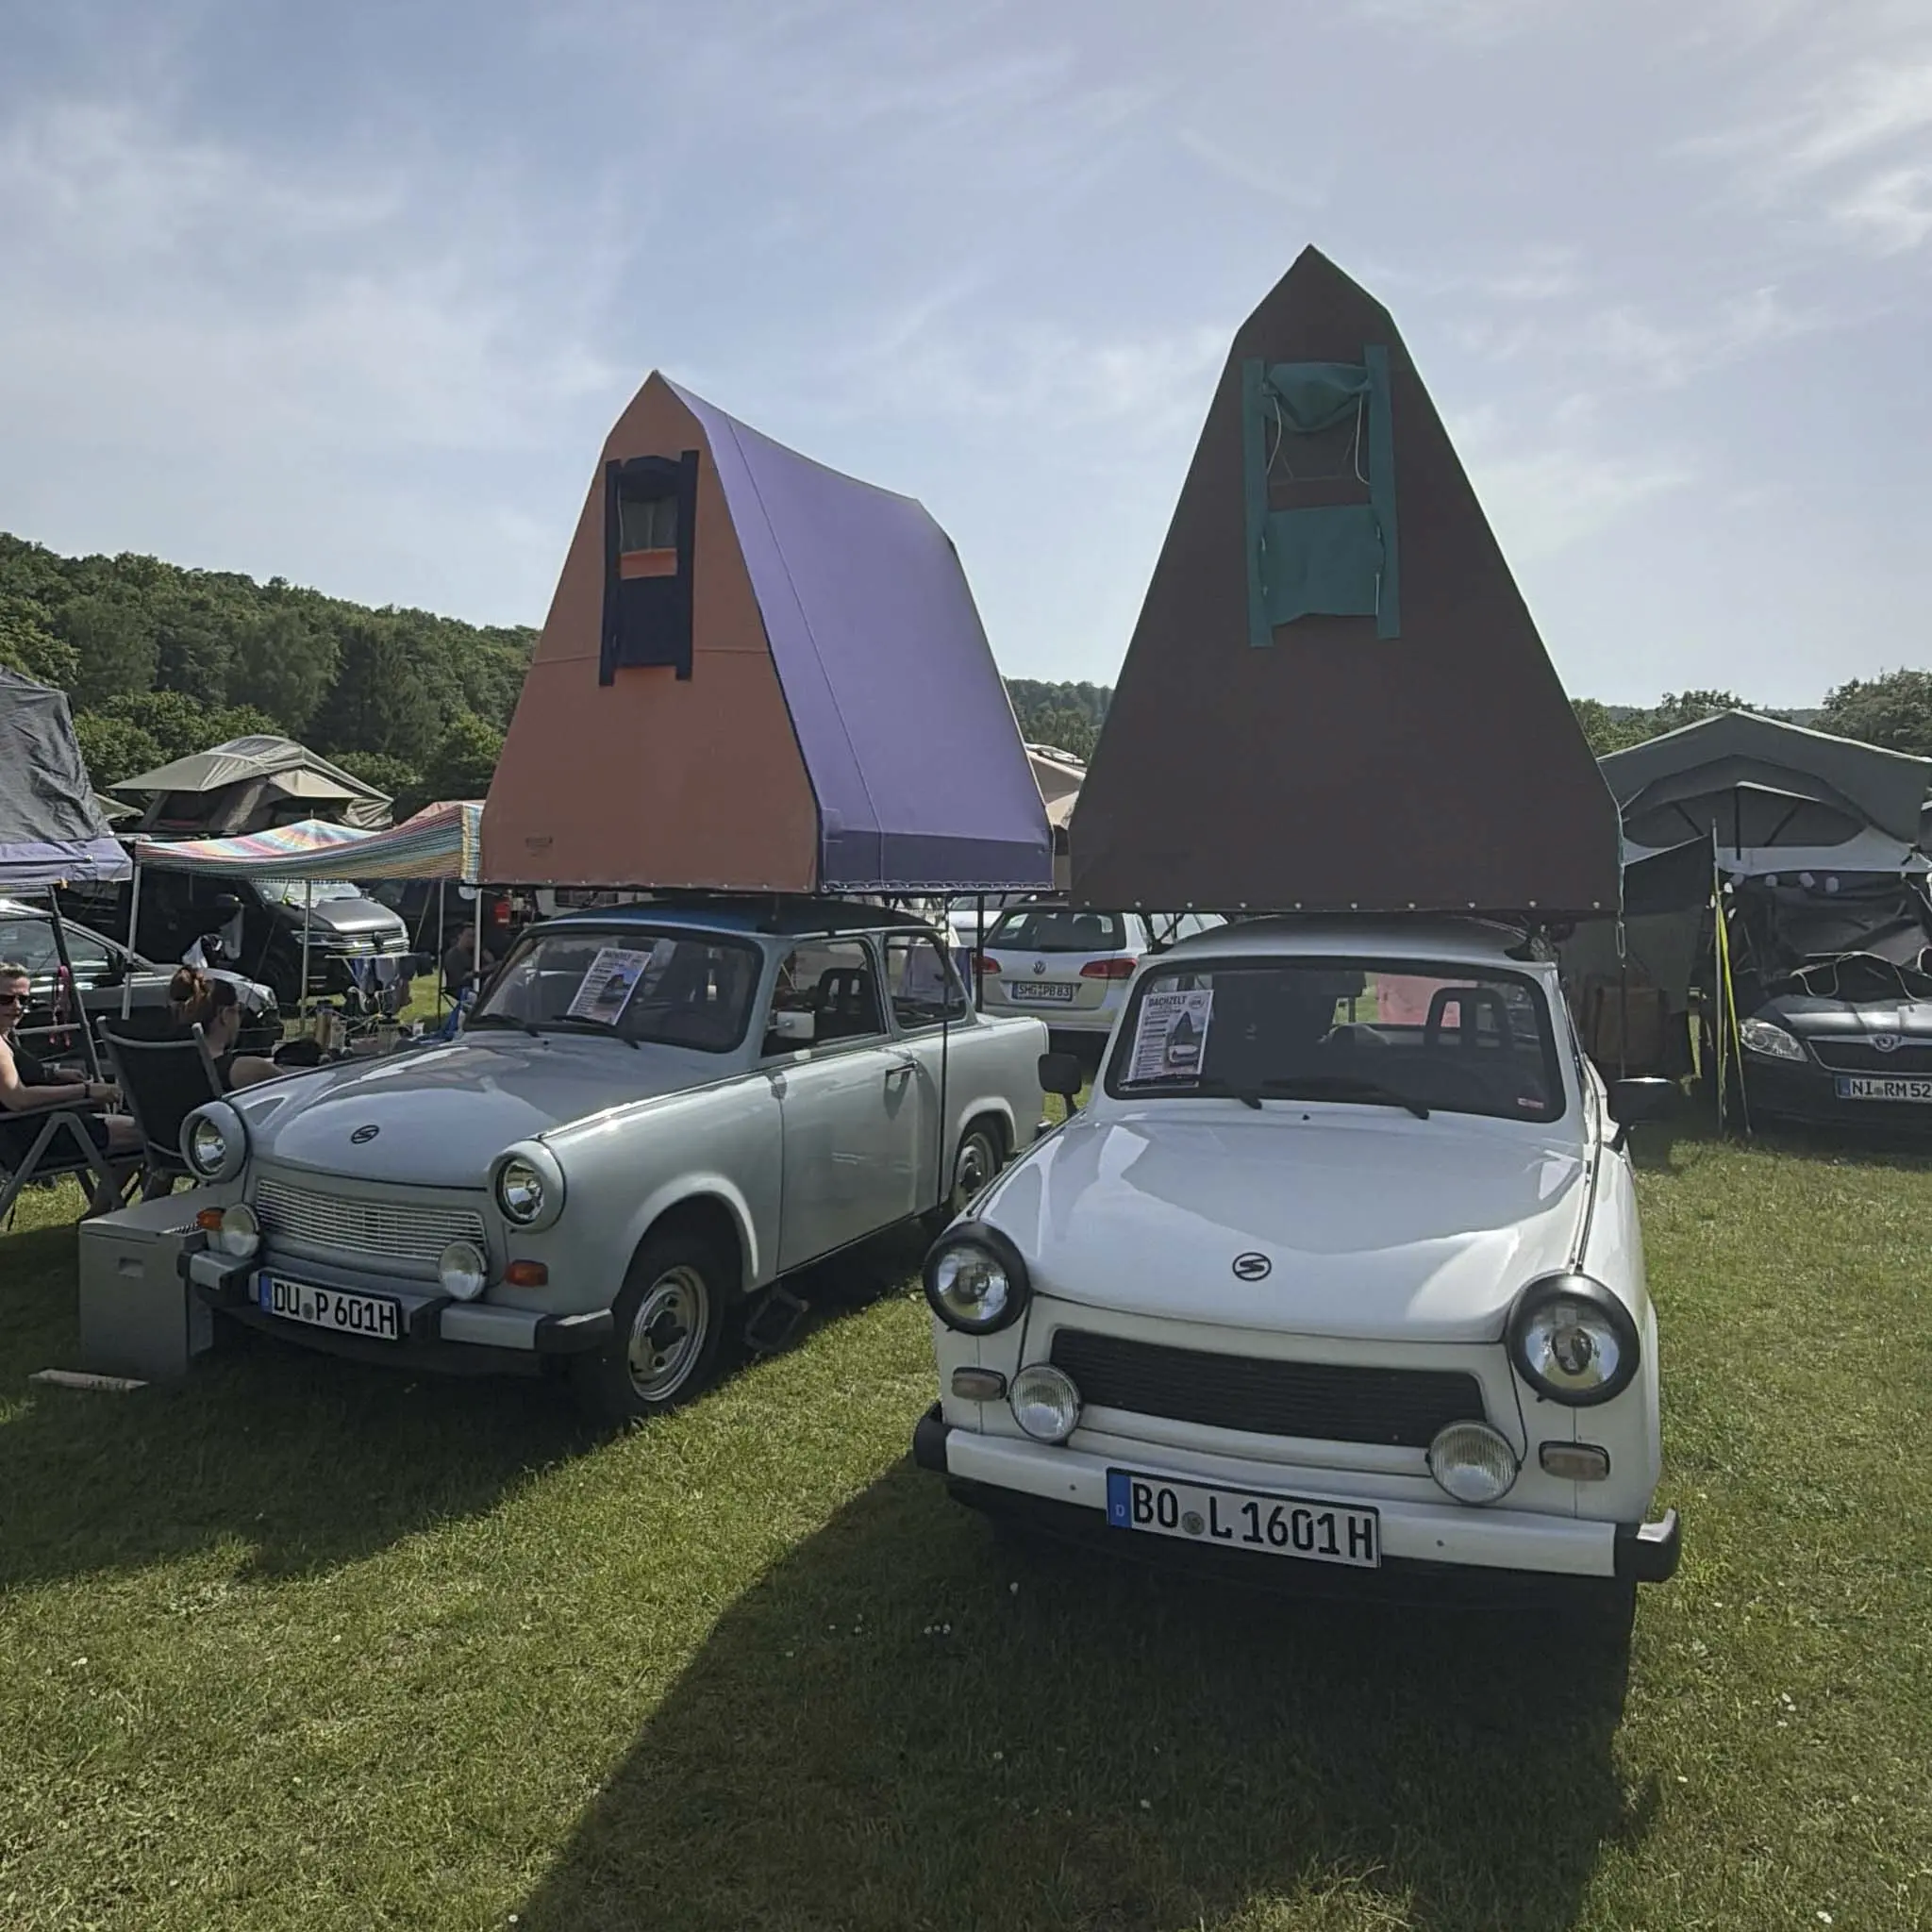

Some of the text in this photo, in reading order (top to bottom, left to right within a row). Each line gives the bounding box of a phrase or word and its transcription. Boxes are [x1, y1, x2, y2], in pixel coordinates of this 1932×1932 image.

[1148, 996, 1187, 1008] DACHZELT
[1852, 1081, 1932, 1098] NI RM 52
[274, 1282, 394, 1336] DU P 601H
[1132, 1483, 1179, 1529] BO
[1209, 1496, 1232, 1539] L
[1241, 1501, 1373, 1560] 1601H
